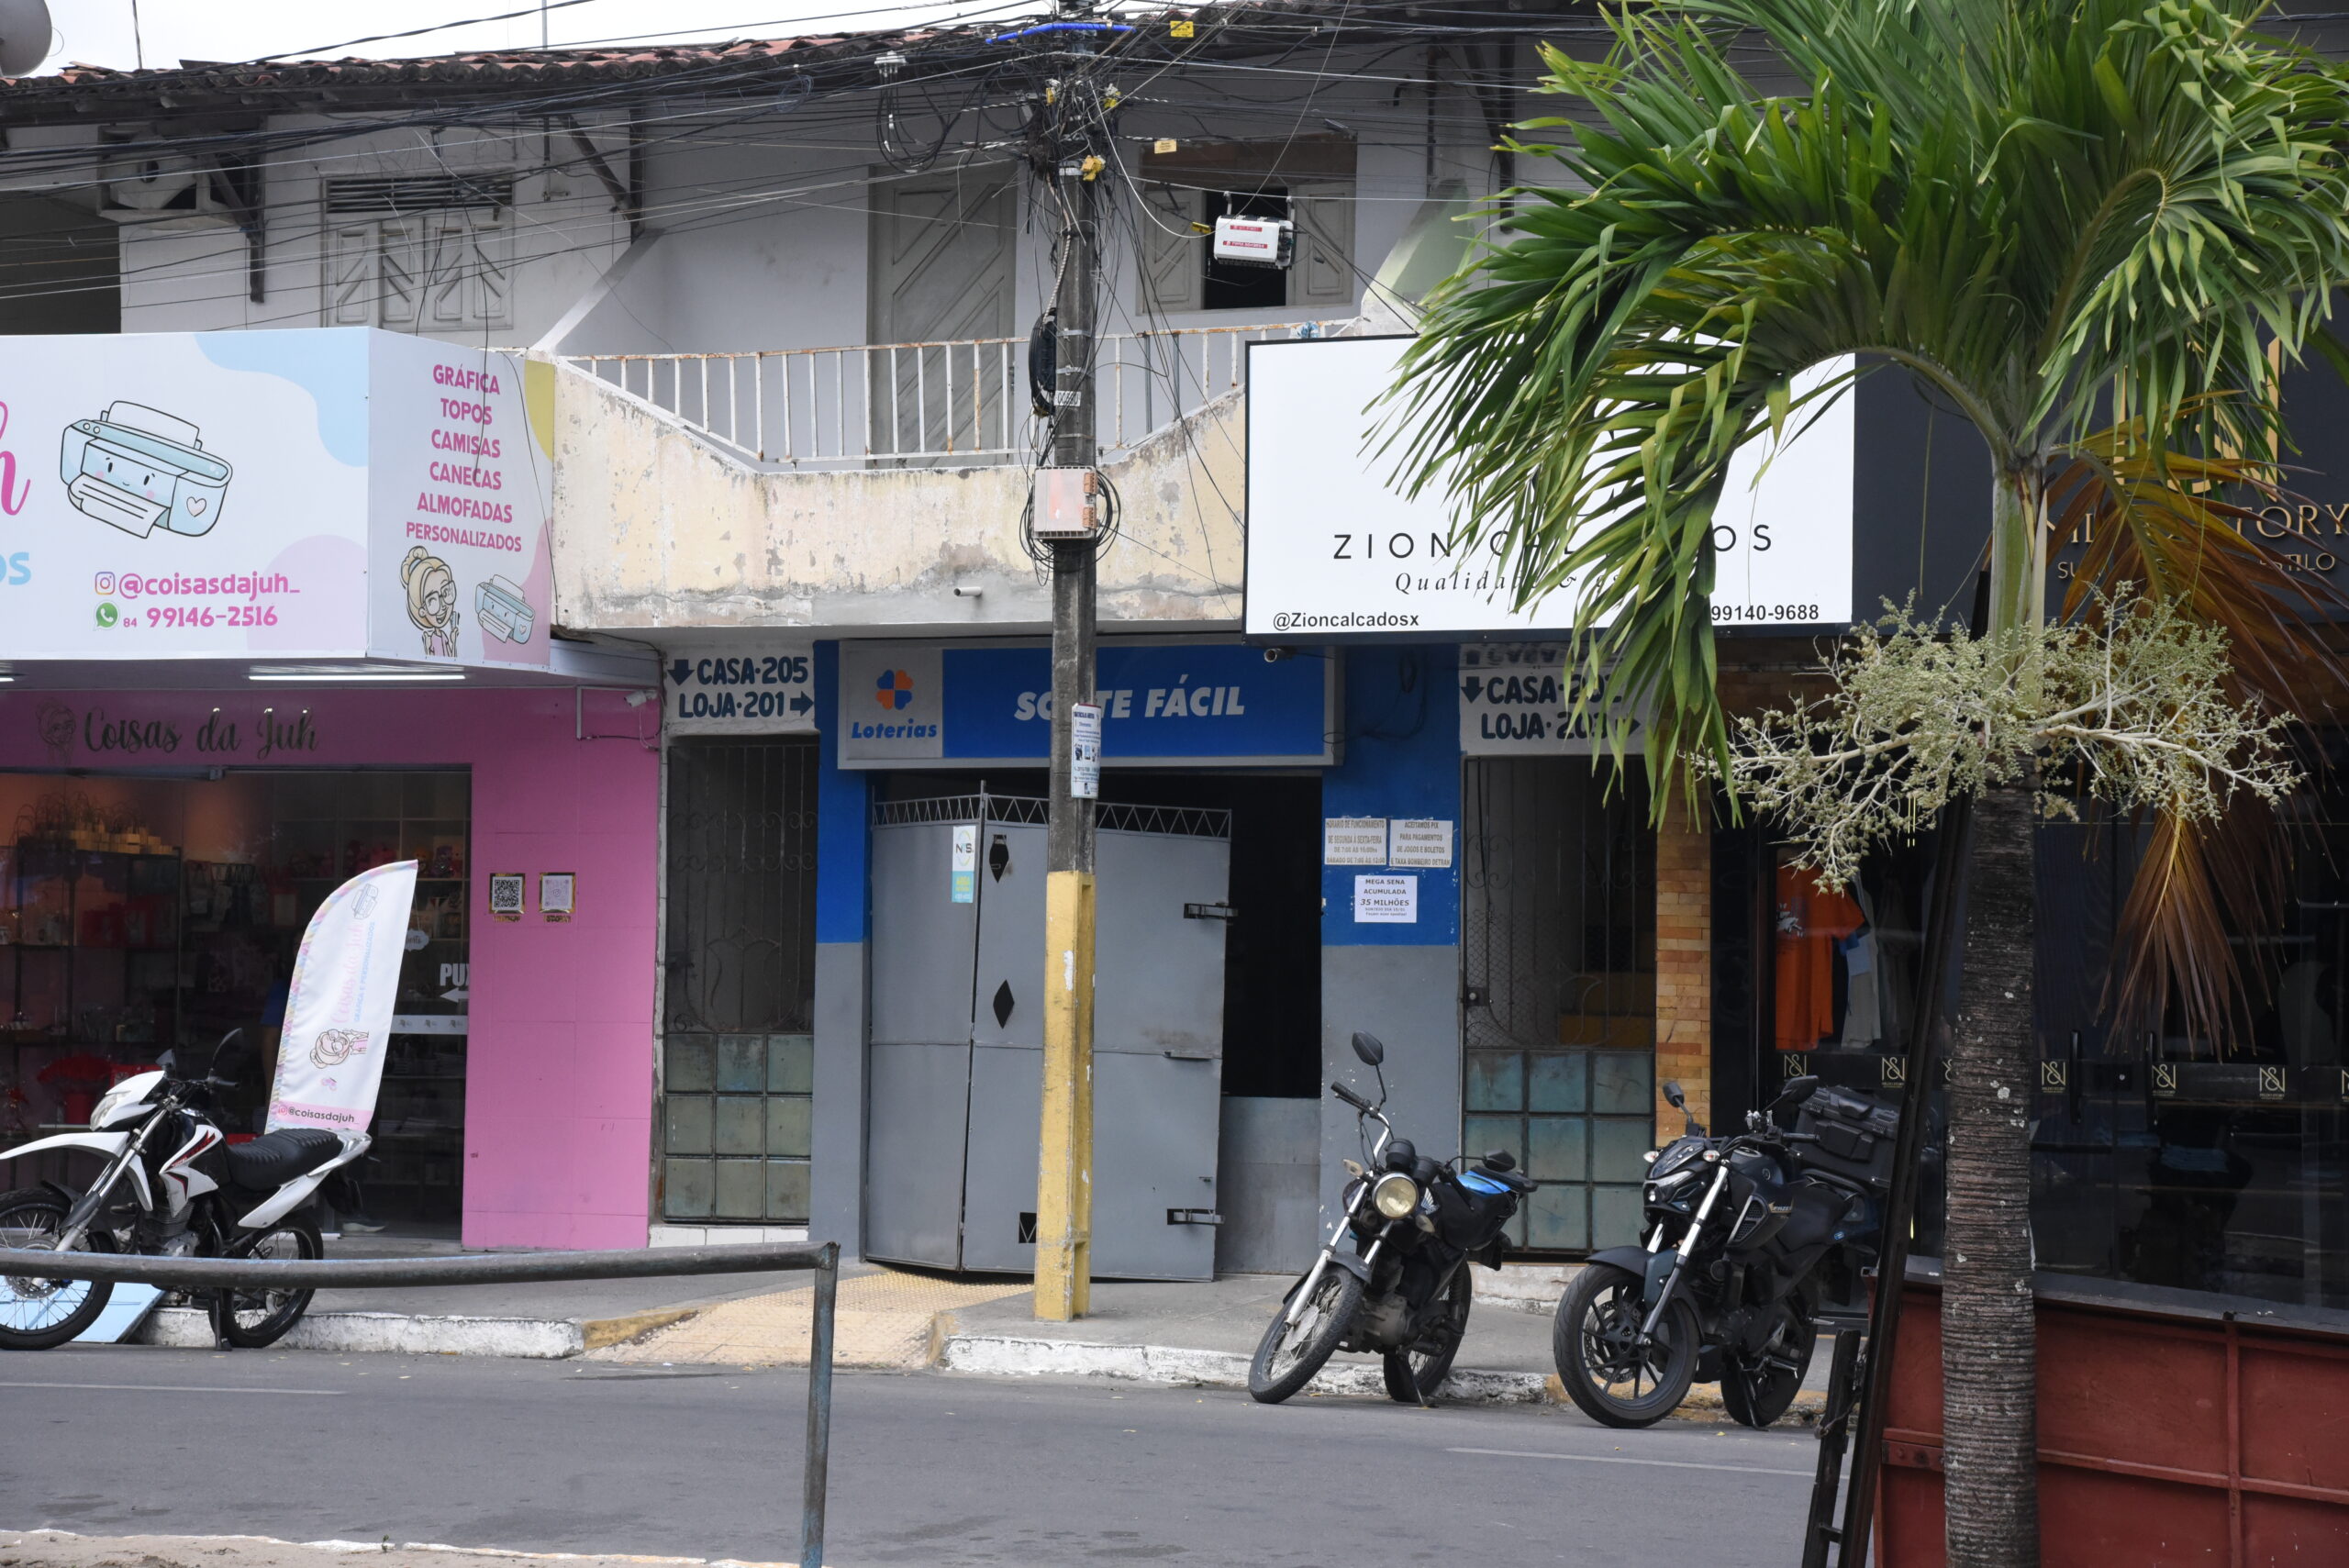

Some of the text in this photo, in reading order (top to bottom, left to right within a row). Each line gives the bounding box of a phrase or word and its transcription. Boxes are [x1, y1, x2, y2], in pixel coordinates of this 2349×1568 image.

[433, 363, 500, 395] GRÁFICA
[440, 398, 493, 425] TOPOS
[431, 428, 501, 459] CAMISAS
[429, 462, 502, 490] CANECAS
[417, 492, 513, 524] ALMOFADAS
[406, 521, 522, 552] PERSONALIZADOS
[1333, 532, 1451, 560] ZION
[123, 606, 278, 628] 84 99146-2516
[1273, 611, 1419, 631] @Zioncalcadosx
[1711, 604, 1820, 621] 99140-9688
[1014, 673, 1245, 721] SOTE FÁCIL
[83, 706, 320, 761] Coisas da Juh
[851, 717, 938, 739] Loterias
